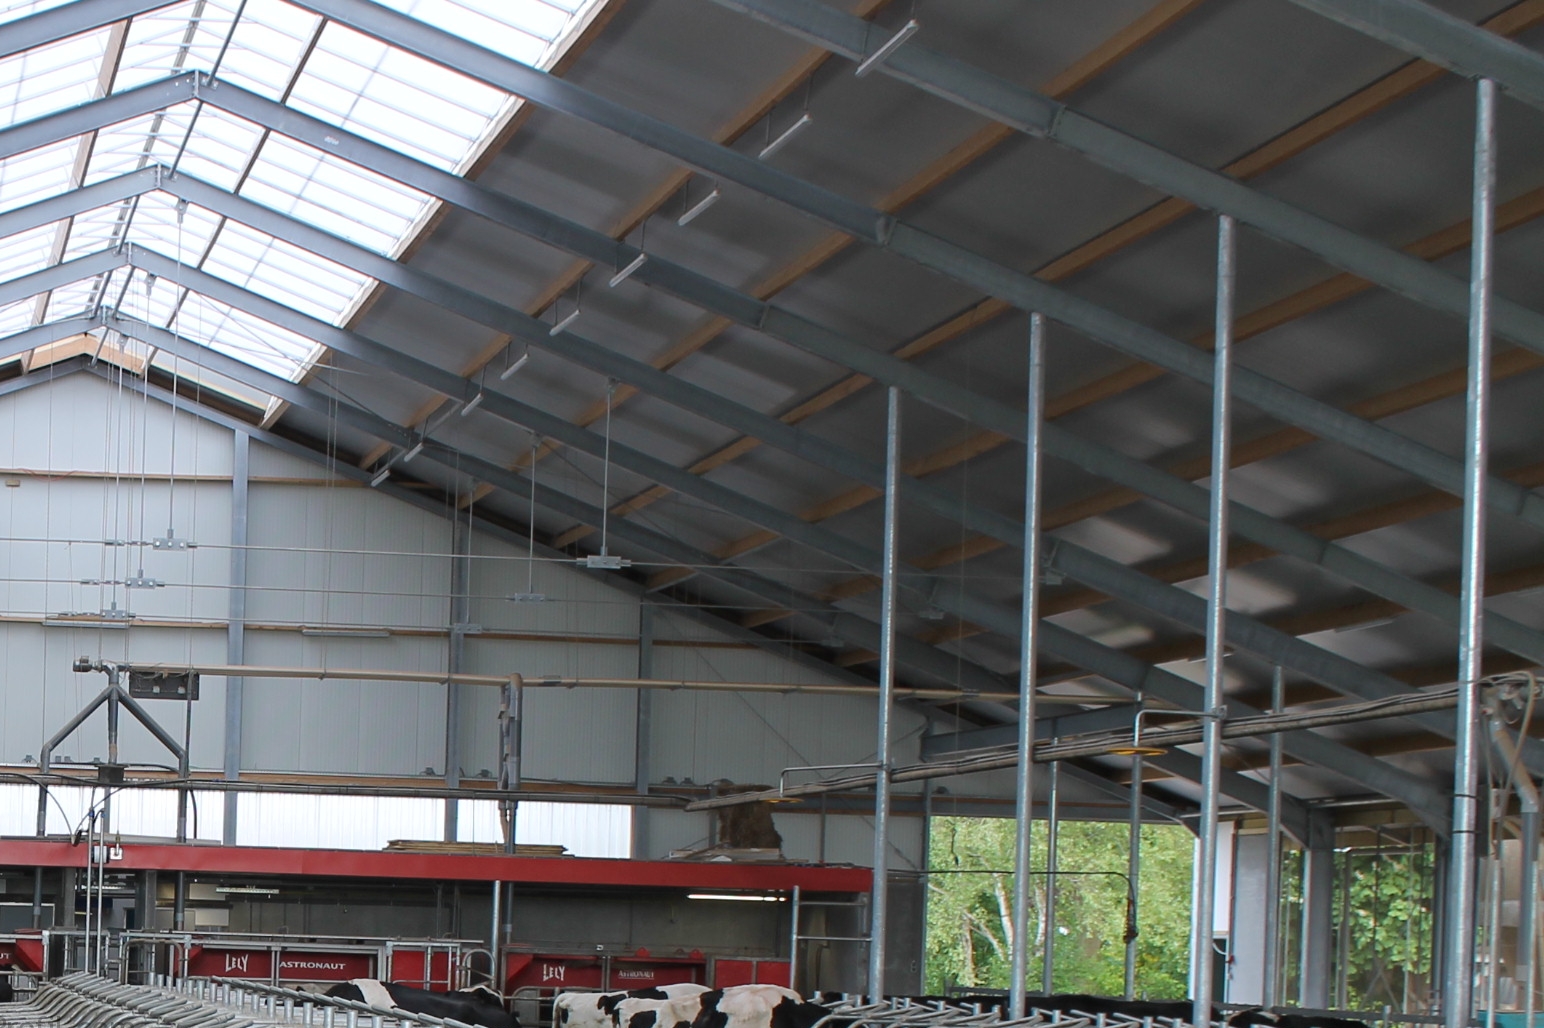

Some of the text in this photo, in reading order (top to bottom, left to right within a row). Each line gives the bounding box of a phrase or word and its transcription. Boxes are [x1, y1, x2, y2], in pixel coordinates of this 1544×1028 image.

[225, 953, 249, 973] LELY
[279, 961, 346, 970] ASTRONAUT
[543, 963, 565, 981] LELY
